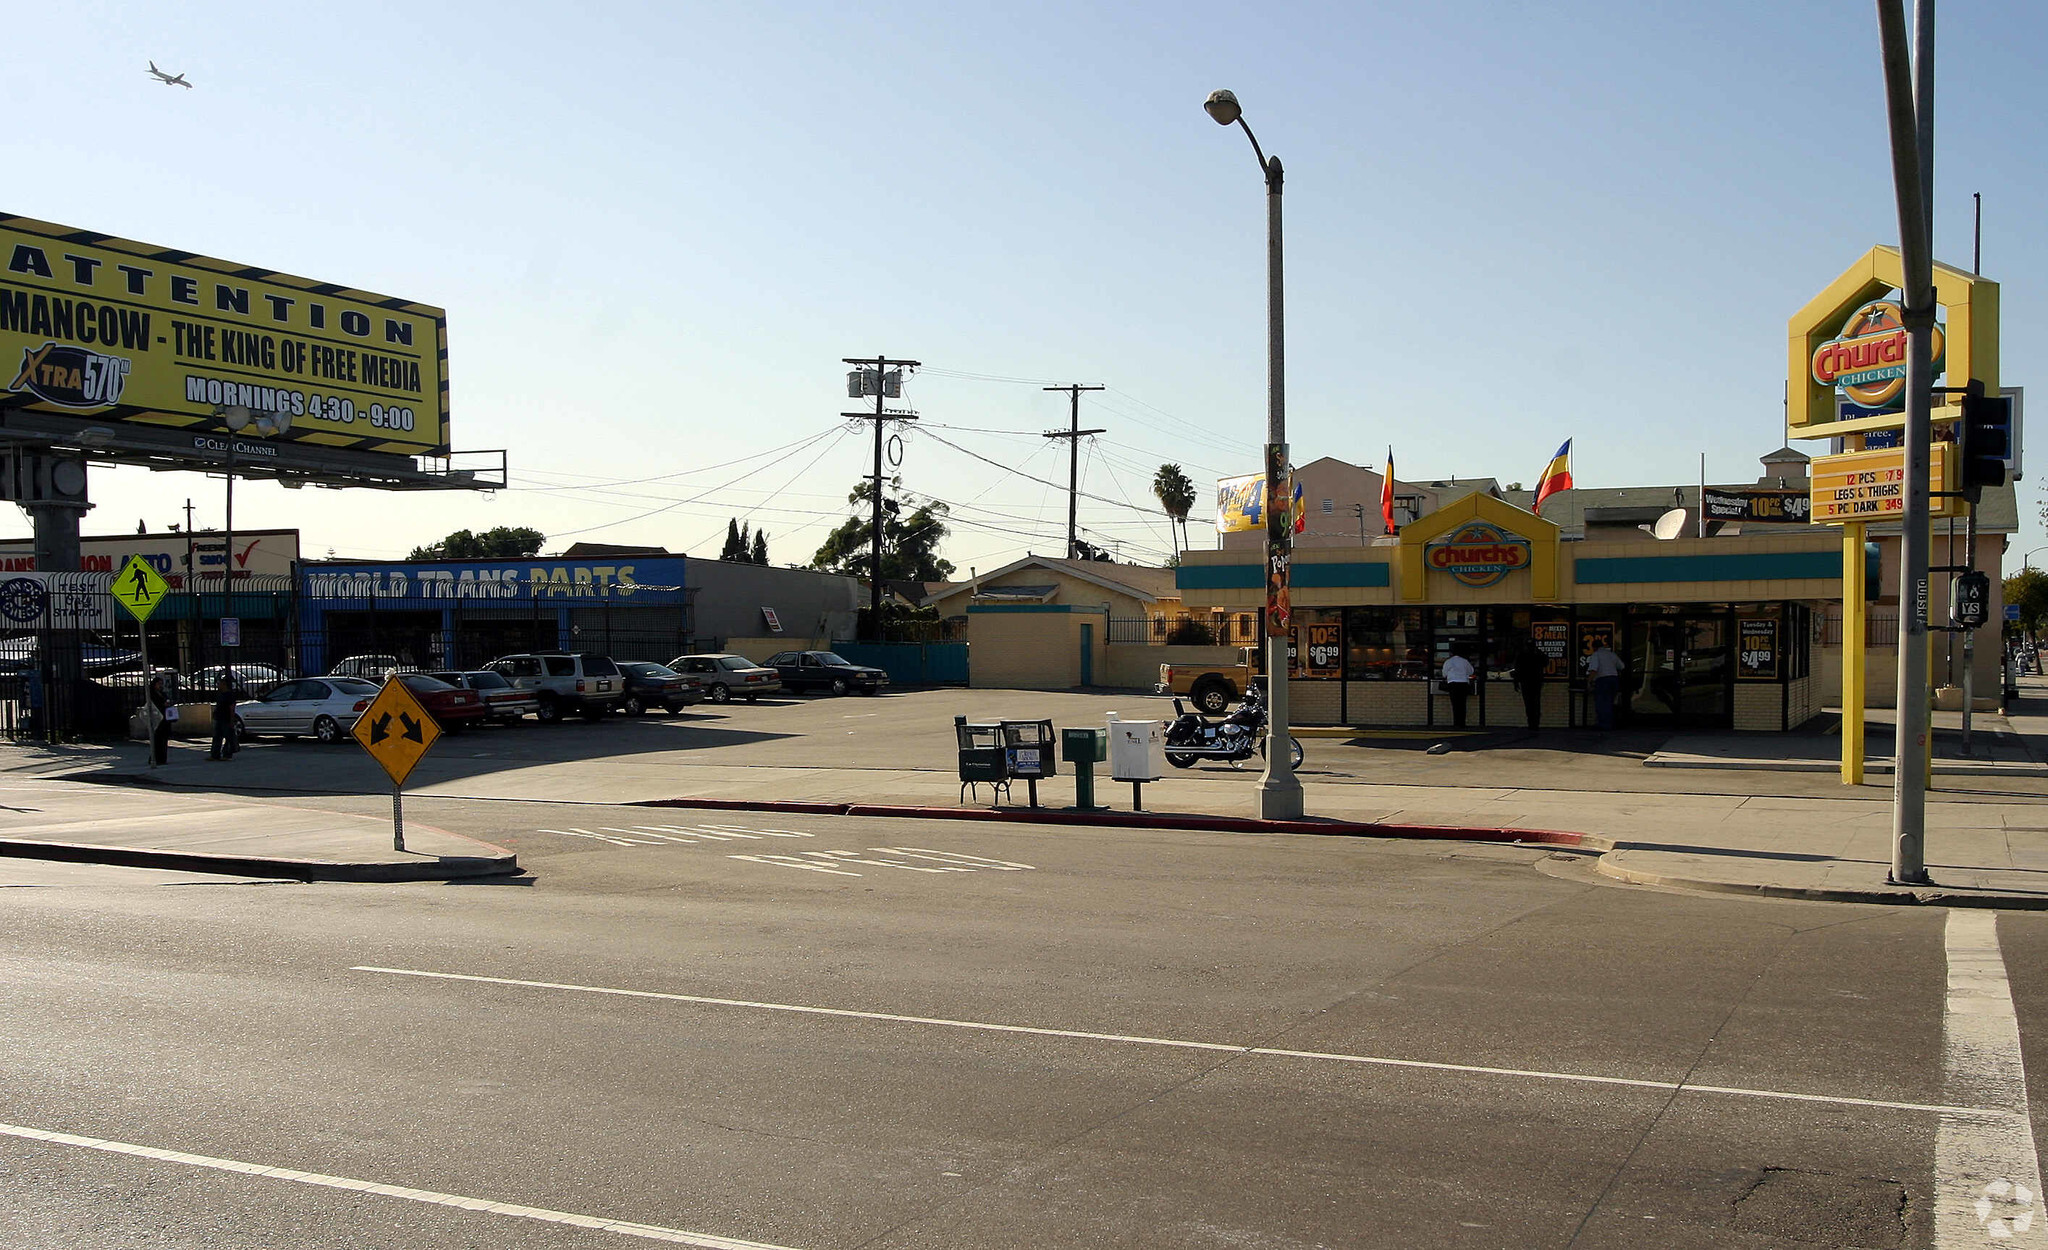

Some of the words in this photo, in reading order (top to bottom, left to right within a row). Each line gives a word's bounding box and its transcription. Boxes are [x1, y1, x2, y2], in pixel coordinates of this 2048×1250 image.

[8, 243, 413, 346] ATTENTION
[0, 288, 150, 351] MANCOW
[171, 320, 216, 360] THE
[221, 329, 275, 370] KING
[281, 339, 306, 374] OF
[311, 344, 357, 382] FREE
[361, 353, 422, 393] MEDIA
[83, 354, 121, 403] 570
[1841, 365, 1905, 385] CHICKEN
[185, 374, 304, 416] MORNINGS
[308, 394, 354, 423] 4:30
[370, 403, 414, 432] 9:00
[1846, 474, 1855, 485] 12
[1858, 471, 1875, 484] PCS
[1834, 488, 1854, 500] LEGS
[1858, 488, 1863, 498] &
[1867, 484, 1899, 498] THIGHS
[1828, 504, 1835, 515] 5
[1837, 502, 1849, 514] PC
[1853, 500, 1878, 513] DARK
[199, 555, 228, 564] SMO
[1451, 565, 1502, 573] CHICKEN
[59, 583, 96, 592] TEST
[308, 571, 408, 599] WORLD
[417, 569, 518, 598] TRANS
[530, 566, 635, 597] PARTS
[53, 608, 102, 618] STATION
[1963, 603, 1979, 614] YS
